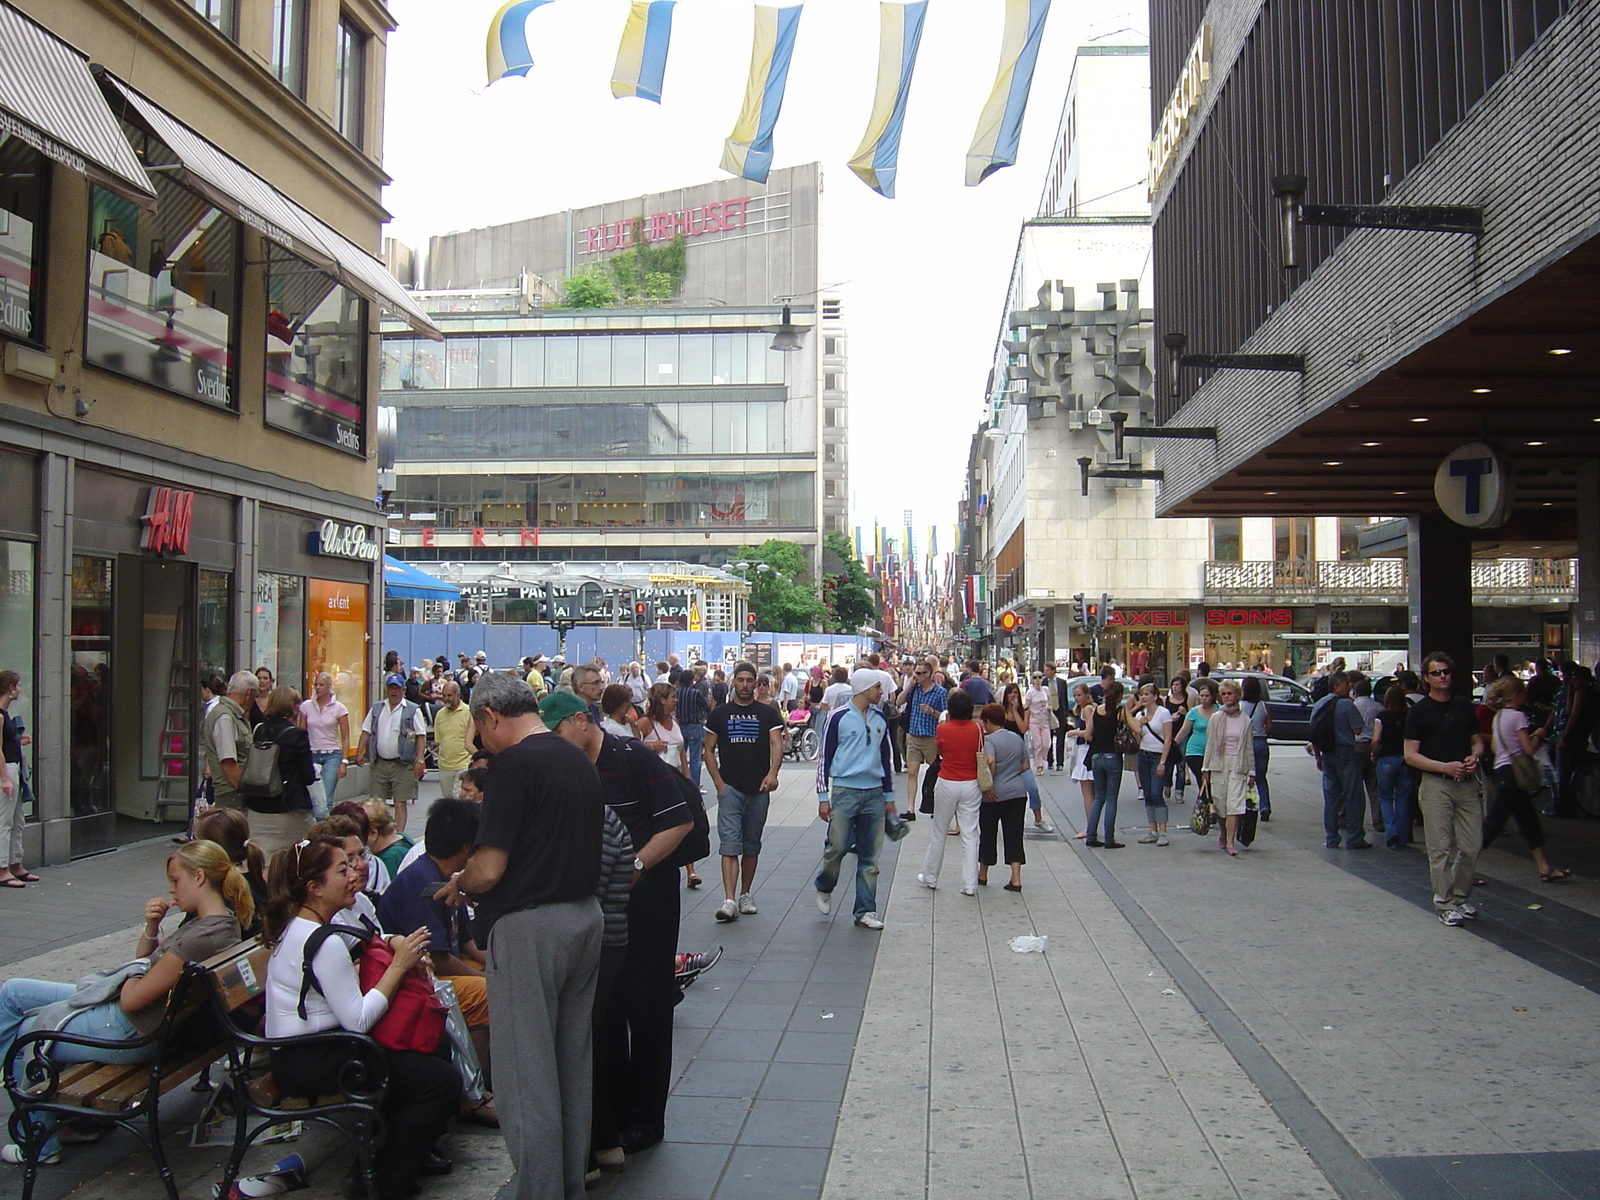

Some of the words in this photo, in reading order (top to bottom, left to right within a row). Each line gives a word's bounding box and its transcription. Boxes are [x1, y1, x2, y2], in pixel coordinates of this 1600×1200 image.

[586, 196, 751, 255] KULTURHUSET
[197, 368, 231, 404] Svedins
[336, 423, 360, 450] Svedins
[1448, 457, 1493, 515] T
[143, 486, 194, 555] H&M
[257, 583, 273, 603] REA
